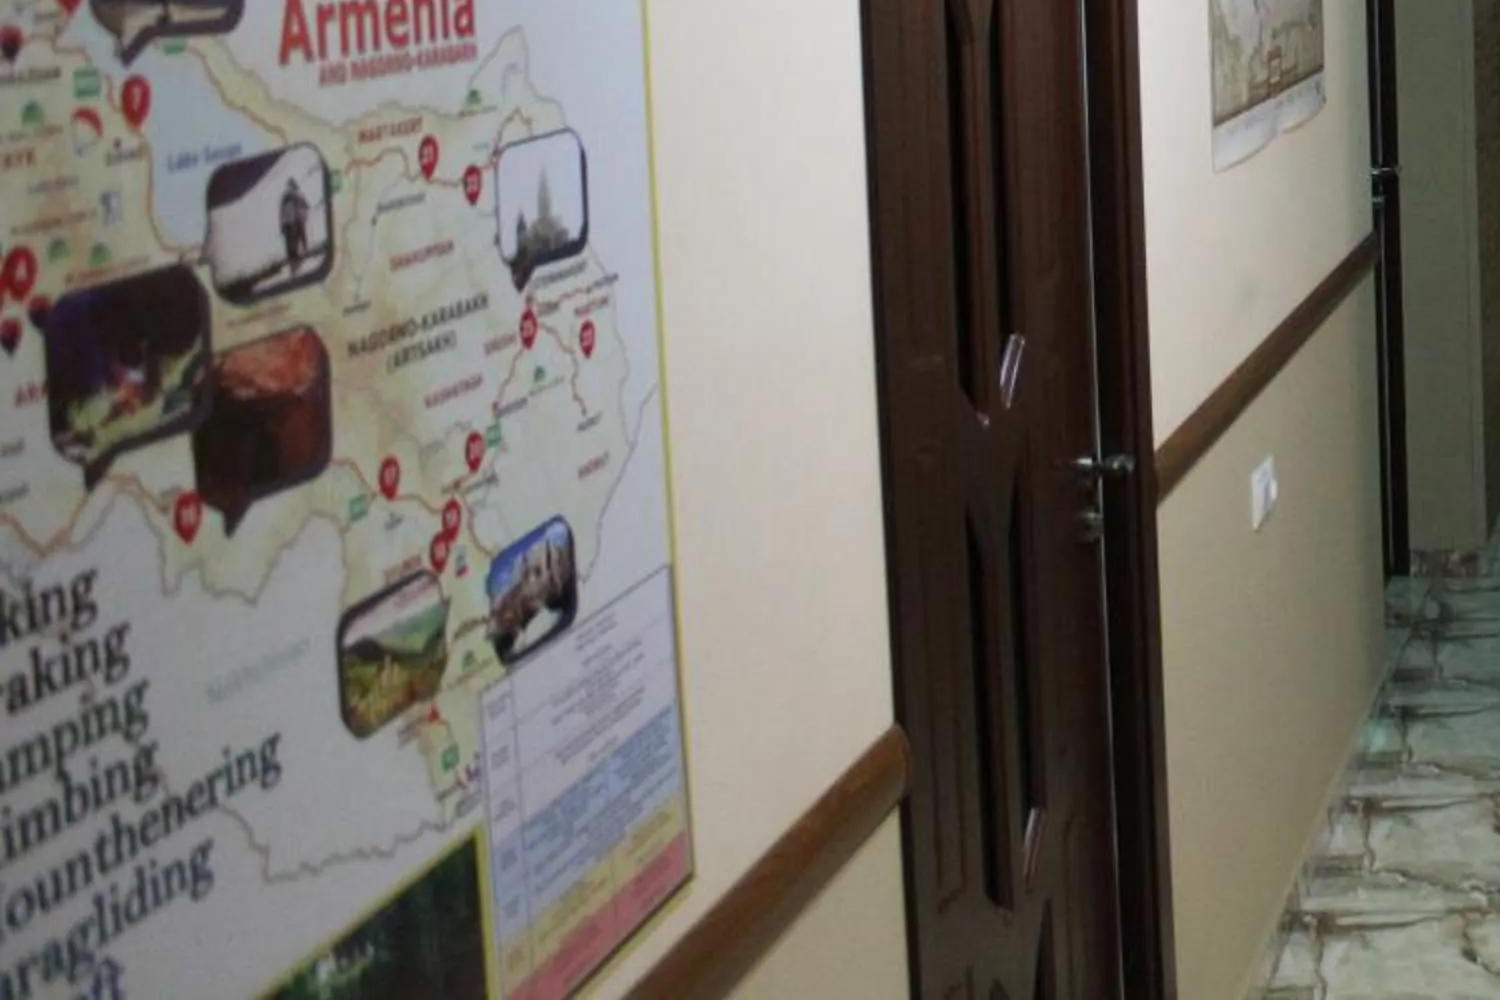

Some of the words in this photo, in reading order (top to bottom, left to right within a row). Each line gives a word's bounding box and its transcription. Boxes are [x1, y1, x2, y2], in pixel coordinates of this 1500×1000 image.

[0, 618, 132, 717] aking
[0, 676, 151, 796] mping
[0, 731, 282, 940] ounthenering
